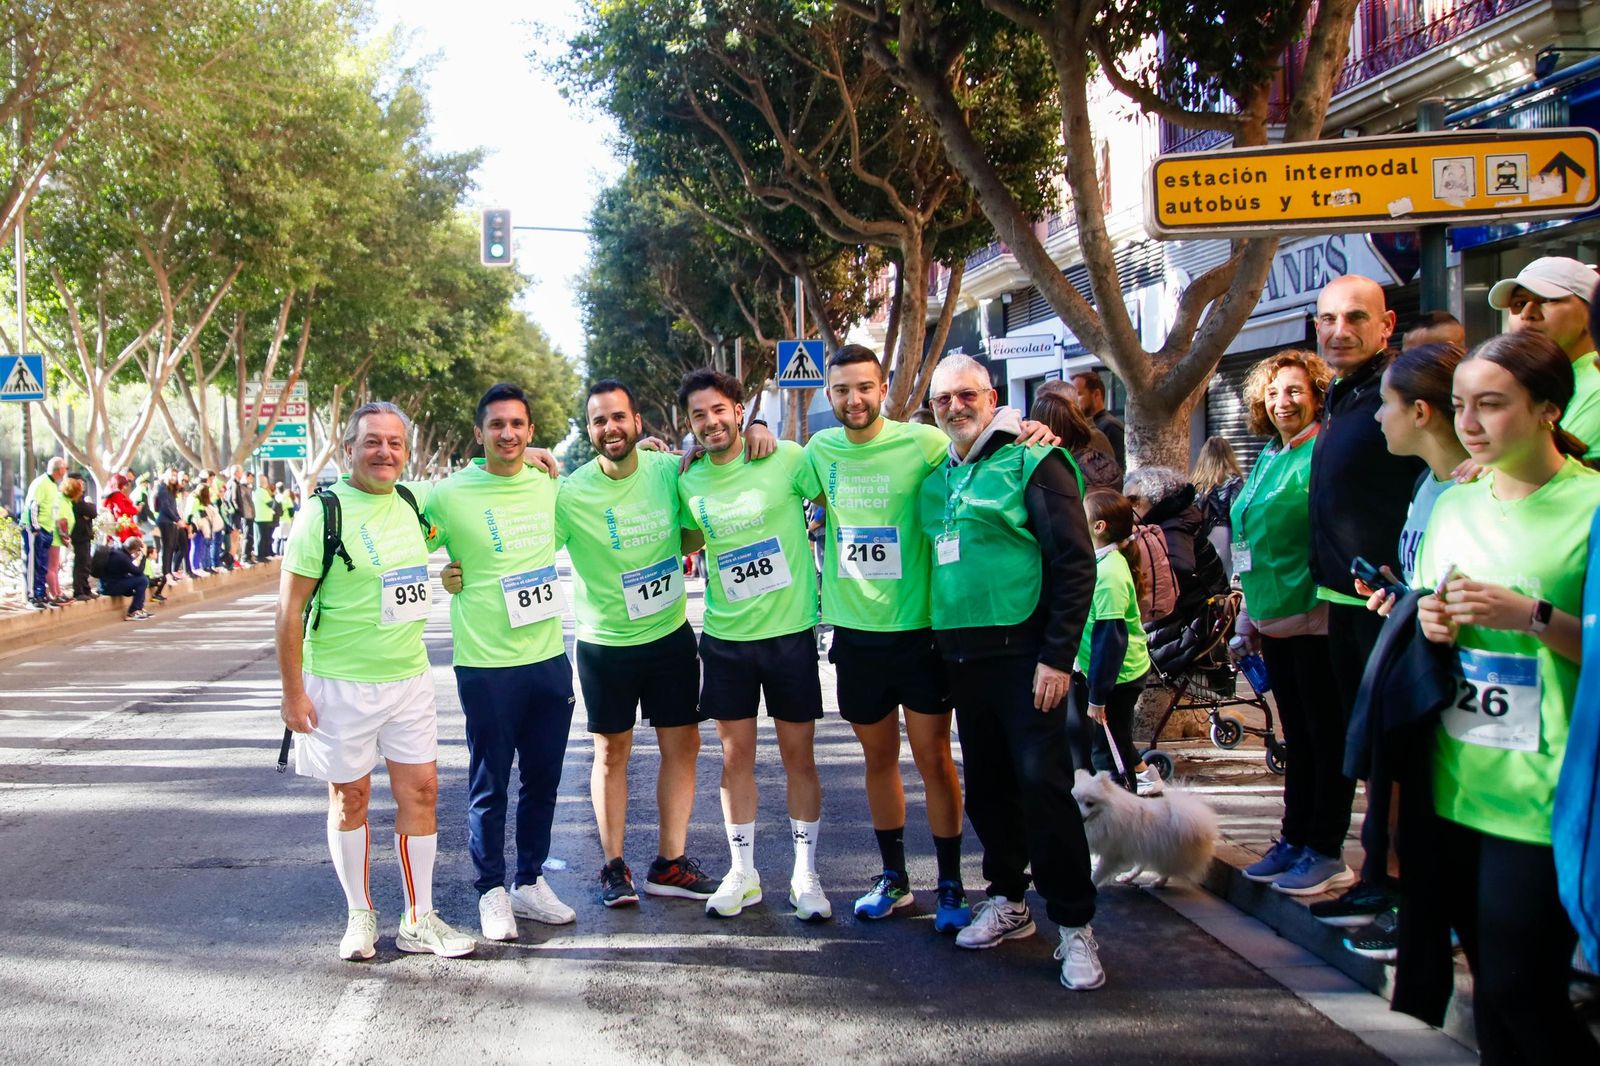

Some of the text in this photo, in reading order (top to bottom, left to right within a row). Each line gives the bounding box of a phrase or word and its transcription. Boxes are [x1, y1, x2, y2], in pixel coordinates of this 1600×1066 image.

[1164, 158, 1418, 188] estación intermodal
[1165, 190, 1361, 214] autobús y trn
[993, 343, 1051, 355] cioccolato
[847, 544, 886, 562] 216
[731, 558, 773, 583] 348
[395, 583, 427, 605] 936
[518, 583, 553, 607] 813
[638, 574, 671, 600] 127
